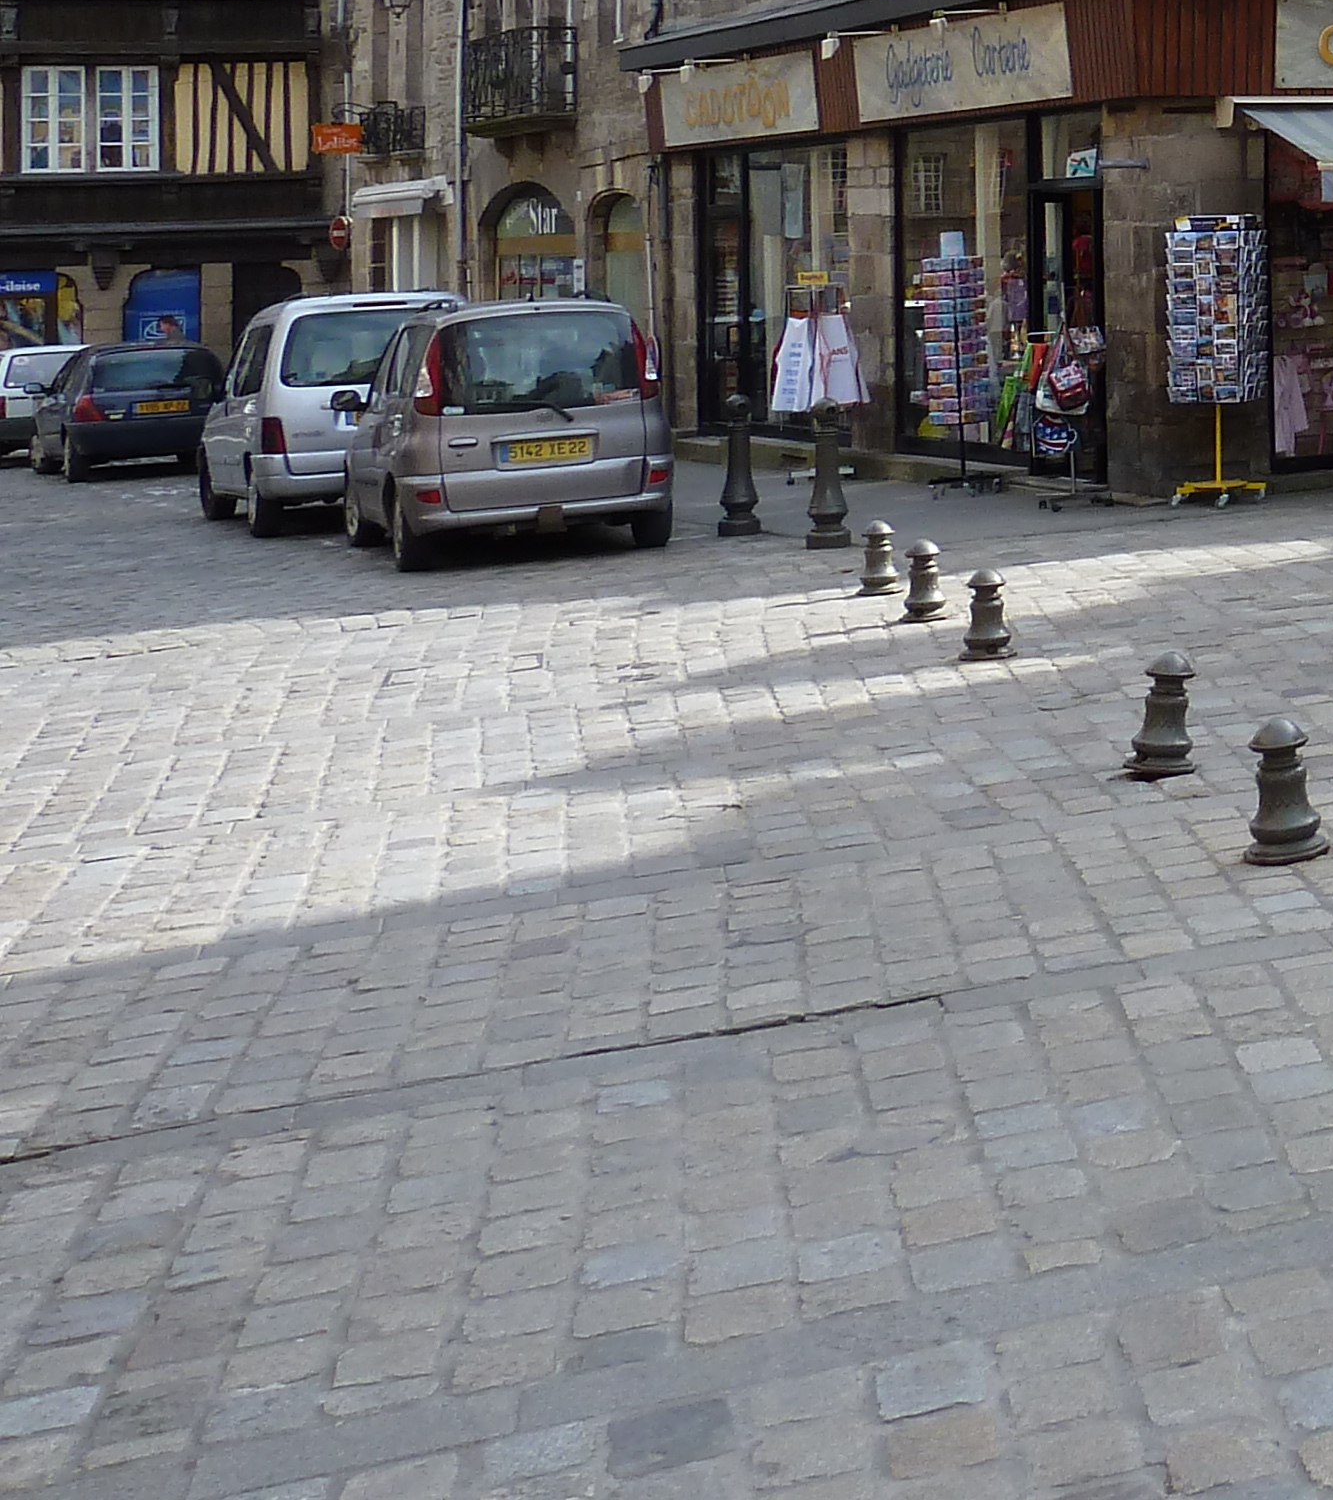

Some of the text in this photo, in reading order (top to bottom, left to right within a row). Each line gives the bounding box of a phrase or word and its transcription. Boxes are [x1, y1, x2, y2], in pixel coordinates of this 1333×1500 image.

[972, 27, 1031, 78] Carterie
[529, 198, 558, 235] Star
[509, 443, 543, 459] 5142
